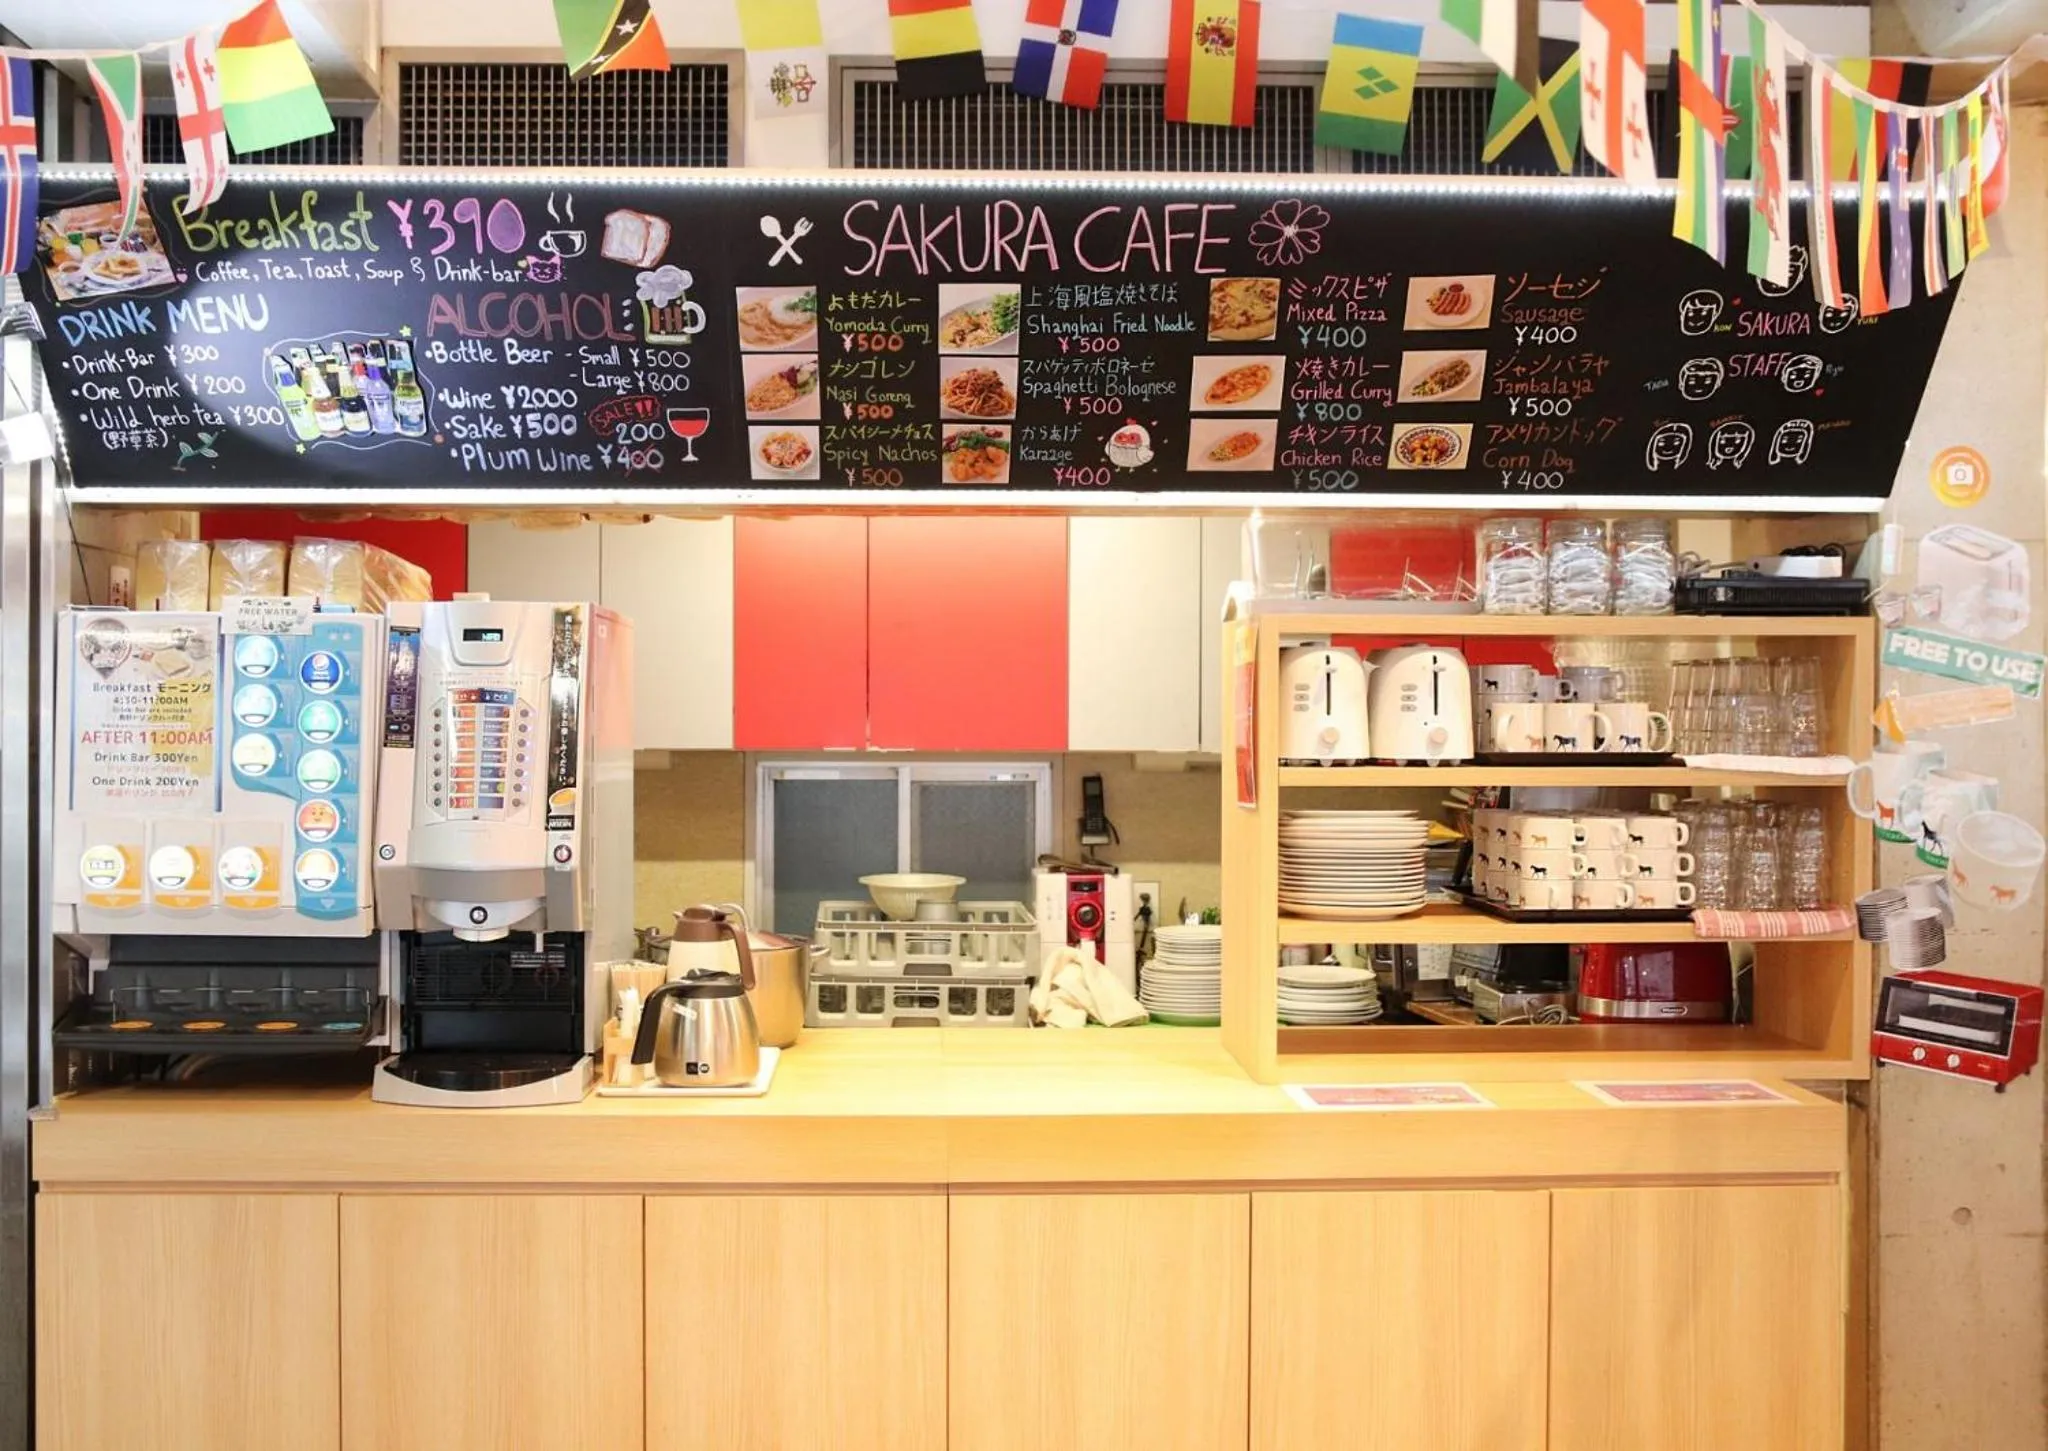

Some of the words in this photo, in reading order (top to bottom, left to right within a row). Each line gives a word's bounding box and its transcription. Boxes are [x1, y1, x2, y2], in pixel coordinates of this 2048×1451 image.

[172, 190, 379, 251] Breakfast
[387, 197, 526, 256] ¥390
[843, 198, 1059, 278] SAKURA
[1074, 203, 1237, 275] CAFE
[196, 258, 260, 283] Coffee,
[363, 259, 404, 288] Soup
[1287, 272, 1393, 301] ミックスピザ
[828, 289, 923, 311] よもだカレー
[1286, 303, 1337, 323] Mixed
[1345, 301, 1388, 322] Pizza
[58, 300, 157, 347] DRINK
[166, 292, 270, 334] MENU
[1026, 312, 1104, 341] Shanghai
[1113, 312, 1148, 333] Fried
[1154, 312, 1196, 332] Noodle
[1500, 301, 1585, 327] Sausage
[1737, 311, 1811, 337] SAKURA
[825, 317, 887, 334] Yomoda
[891, 316, 932, 345] Curry
[1298, 325, 1367, 348] ¥400
[1514, 325, 1578, 346] ¥400
[432, 340, 498, 365] Bottle
[506, 338, 553, 365] Beer
[579, 345, 621, 366] Small
[631, 348, 691, 369] ¥500
[841, 334, 905, 353] ¥500
[1058, 337, 1121, 354] ¥500
[73, 352, 156, 377] Drink-Bar
[165, 345, 220, 367] ¥300
[829, 356, 916, 379] ナシゴレン
[1294, 355, 1391, 380] 焼きカレー
[1492, 349, 1610, 377] ジャンバラヤ
[1729, 352, 1792, 377] STAFF
[81, 381, 122, 403] One
[130, 374, 181, 399] Drink
[187, 373, 247, 396] ¥200
[582, 367, 631, 395] Large
[635, 371, 691, 393] ¥800
[1023, 375, 1099, 405] Spaghetti
[1105, 373, 1178, 403] Bolognese
[1290, 379, 1344, 401] Grilled
[1350, 378, 1394, 408] Curry
[1493, 375, 1595, 400] Jambalaya
[444, 387, 496, 411] Wine
[500, 385, 578, 409] ¥2000
[826, 385, 858, 402] Nasi
[865, 386, 916, 409] Goreng
[1060, 397, 1124, 416] ¥500
[1509, 396, 1573, 417] ¥500
[87, 408, 140, 430] Wild
[150, 404, 191, 426] herb
[195, 403, 226, 426] tea
[228, 404, 285, 427] ¥300
[842, 403, 895, 421] ¥500
[1296, 401, 1362, 422] ¥800
[450, 415, 507, 440] Sake
[512, 413, 578, 439] ¥500
[616, 422, 666, 445] 200
[1021, 422, 1082, 443] からあげ
[1288, 422, 1385, 447] チキンライス
[1486, 414, 1624, 447] アメリカンドッグ
[462, 443, 532, 473] Plum
[537, 448, 594, 472] Wine
[822, 443, 870, 470] Spicy
[878, 441, 938, 462] Nachos
[1281, 449, 1342, 467] Chicken
[1351, 448, 1383, 467] Rice
[1482, 447, 1531, 470] Corn
[1541, 450, 1576, 474] Dog
[845, 467, 904, 488] ¥500
[1053, 466, 1112, 487] ¥400
[1291, 469, 1359, 491] ¥500
[1501, 470, 1565, 491] ¥400
[1888, 631, 1950, 665] FREE
[1953, 646, 1988, 673] TO
[1990, 656, 2039, 684] USE
[92, 682, 152, 693] Breakfast
[81, 731, 134, 745] AFTER
[94, 752, 126, 763] Drink
[130, 752, 150, 763] Bar
[92, 776, 116, 787] One
[119, 776, 153, 787] Drink
